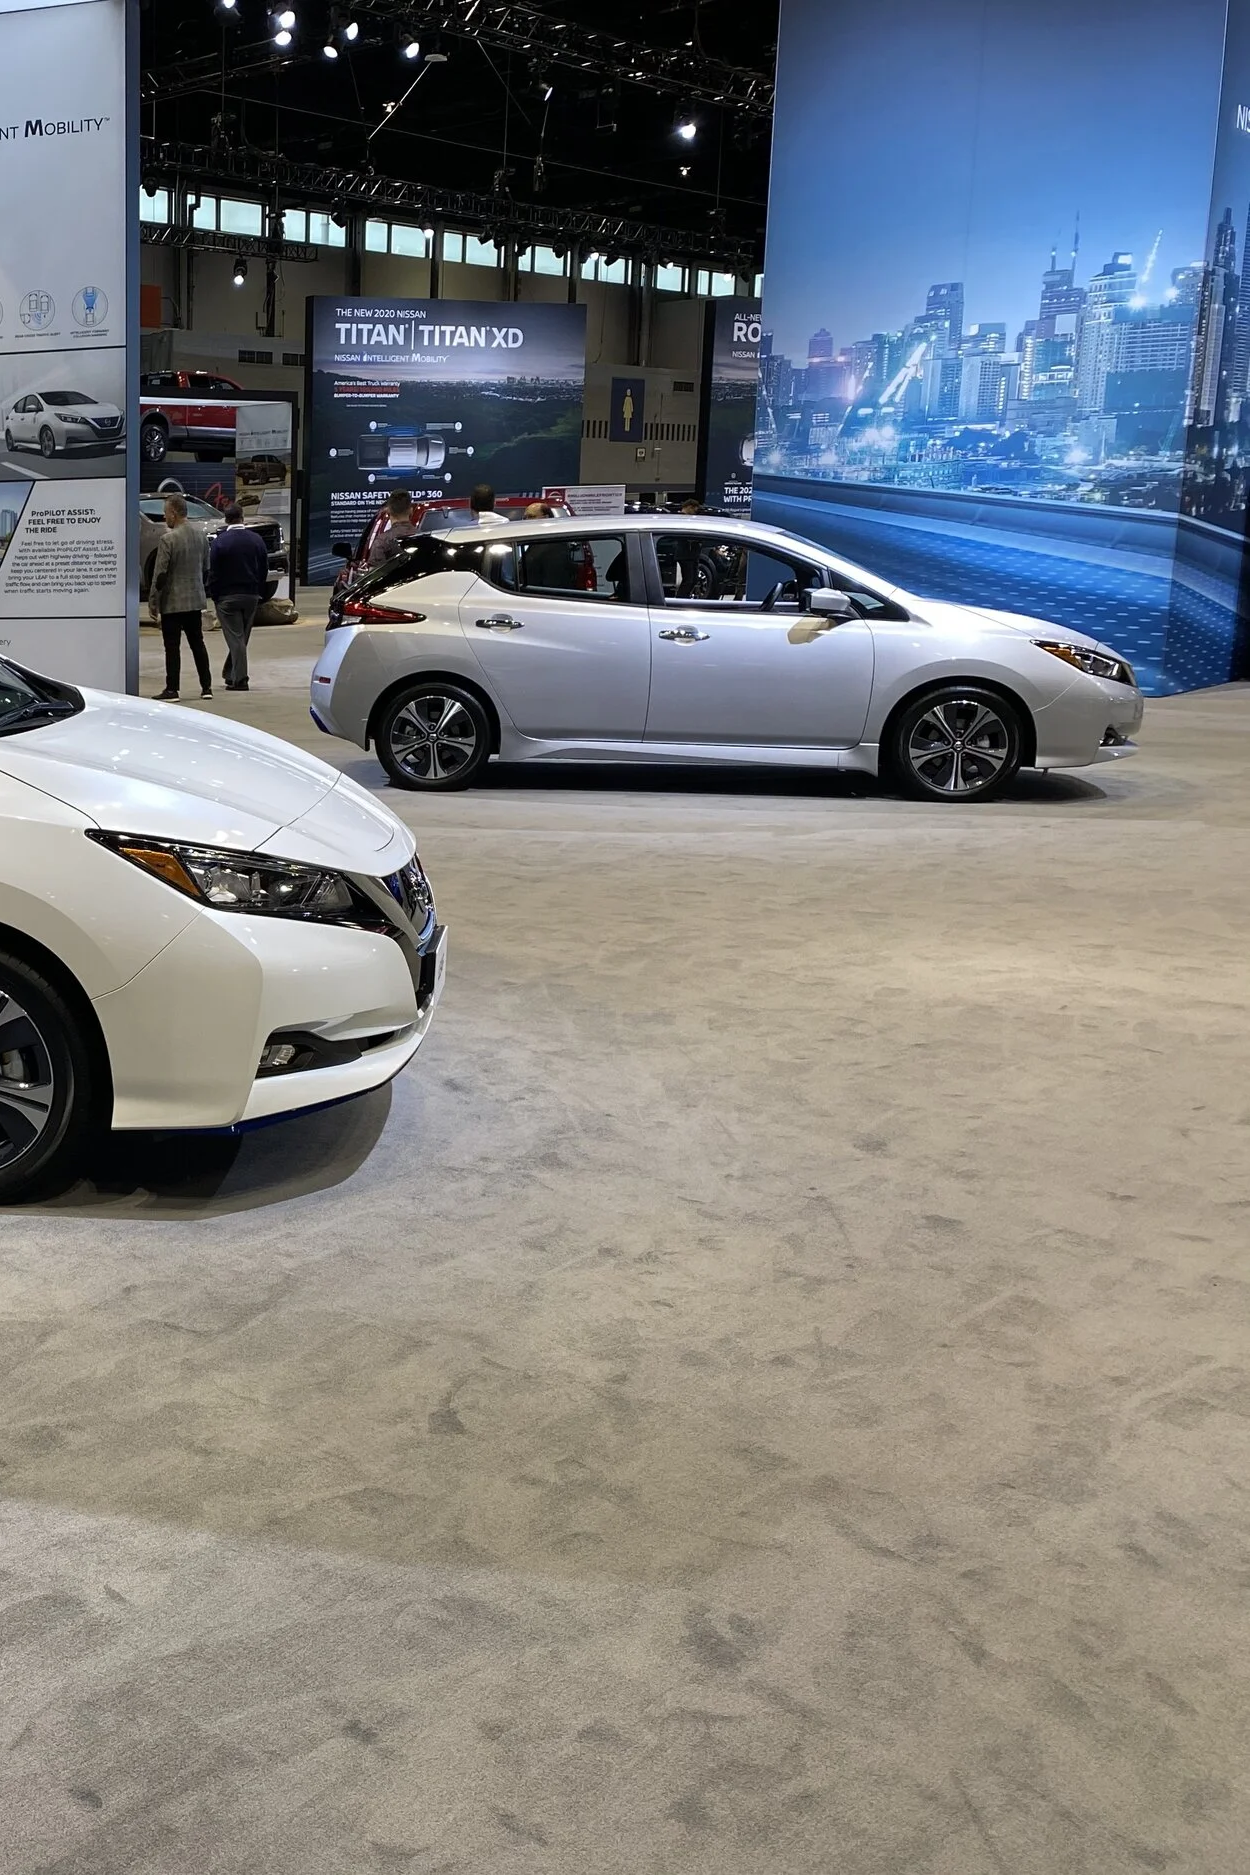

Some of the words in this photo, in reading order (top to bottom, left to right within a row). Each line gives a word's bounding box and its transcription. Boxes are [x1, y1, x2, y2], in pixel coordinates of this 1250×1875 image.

[335, 308, 353, 317] THE
[354, 308, 374, 317] NEW
[374, 309, 395, 318] 2020
[396, 310, 427, 319] NISSAN
[734, 313, 761, 322] ALL-NE
[491, 327, 524, 349] XD
[334, 353, 361, 363] NISSAN
[732, 350, 756, 359] NISSAN
[724, 486, 739, 494] THE
[331, 492, 362, 500] NISSAN
[362, 491, 392, 500] SAFETY
[427, 490, 443, 498] 360
[723, 495, 743, 503] WITH
[31, 509, 66, 517] ProPILOT
[28, 518, 46, 526] FEEL
[65, 517, 76, 525] TO
